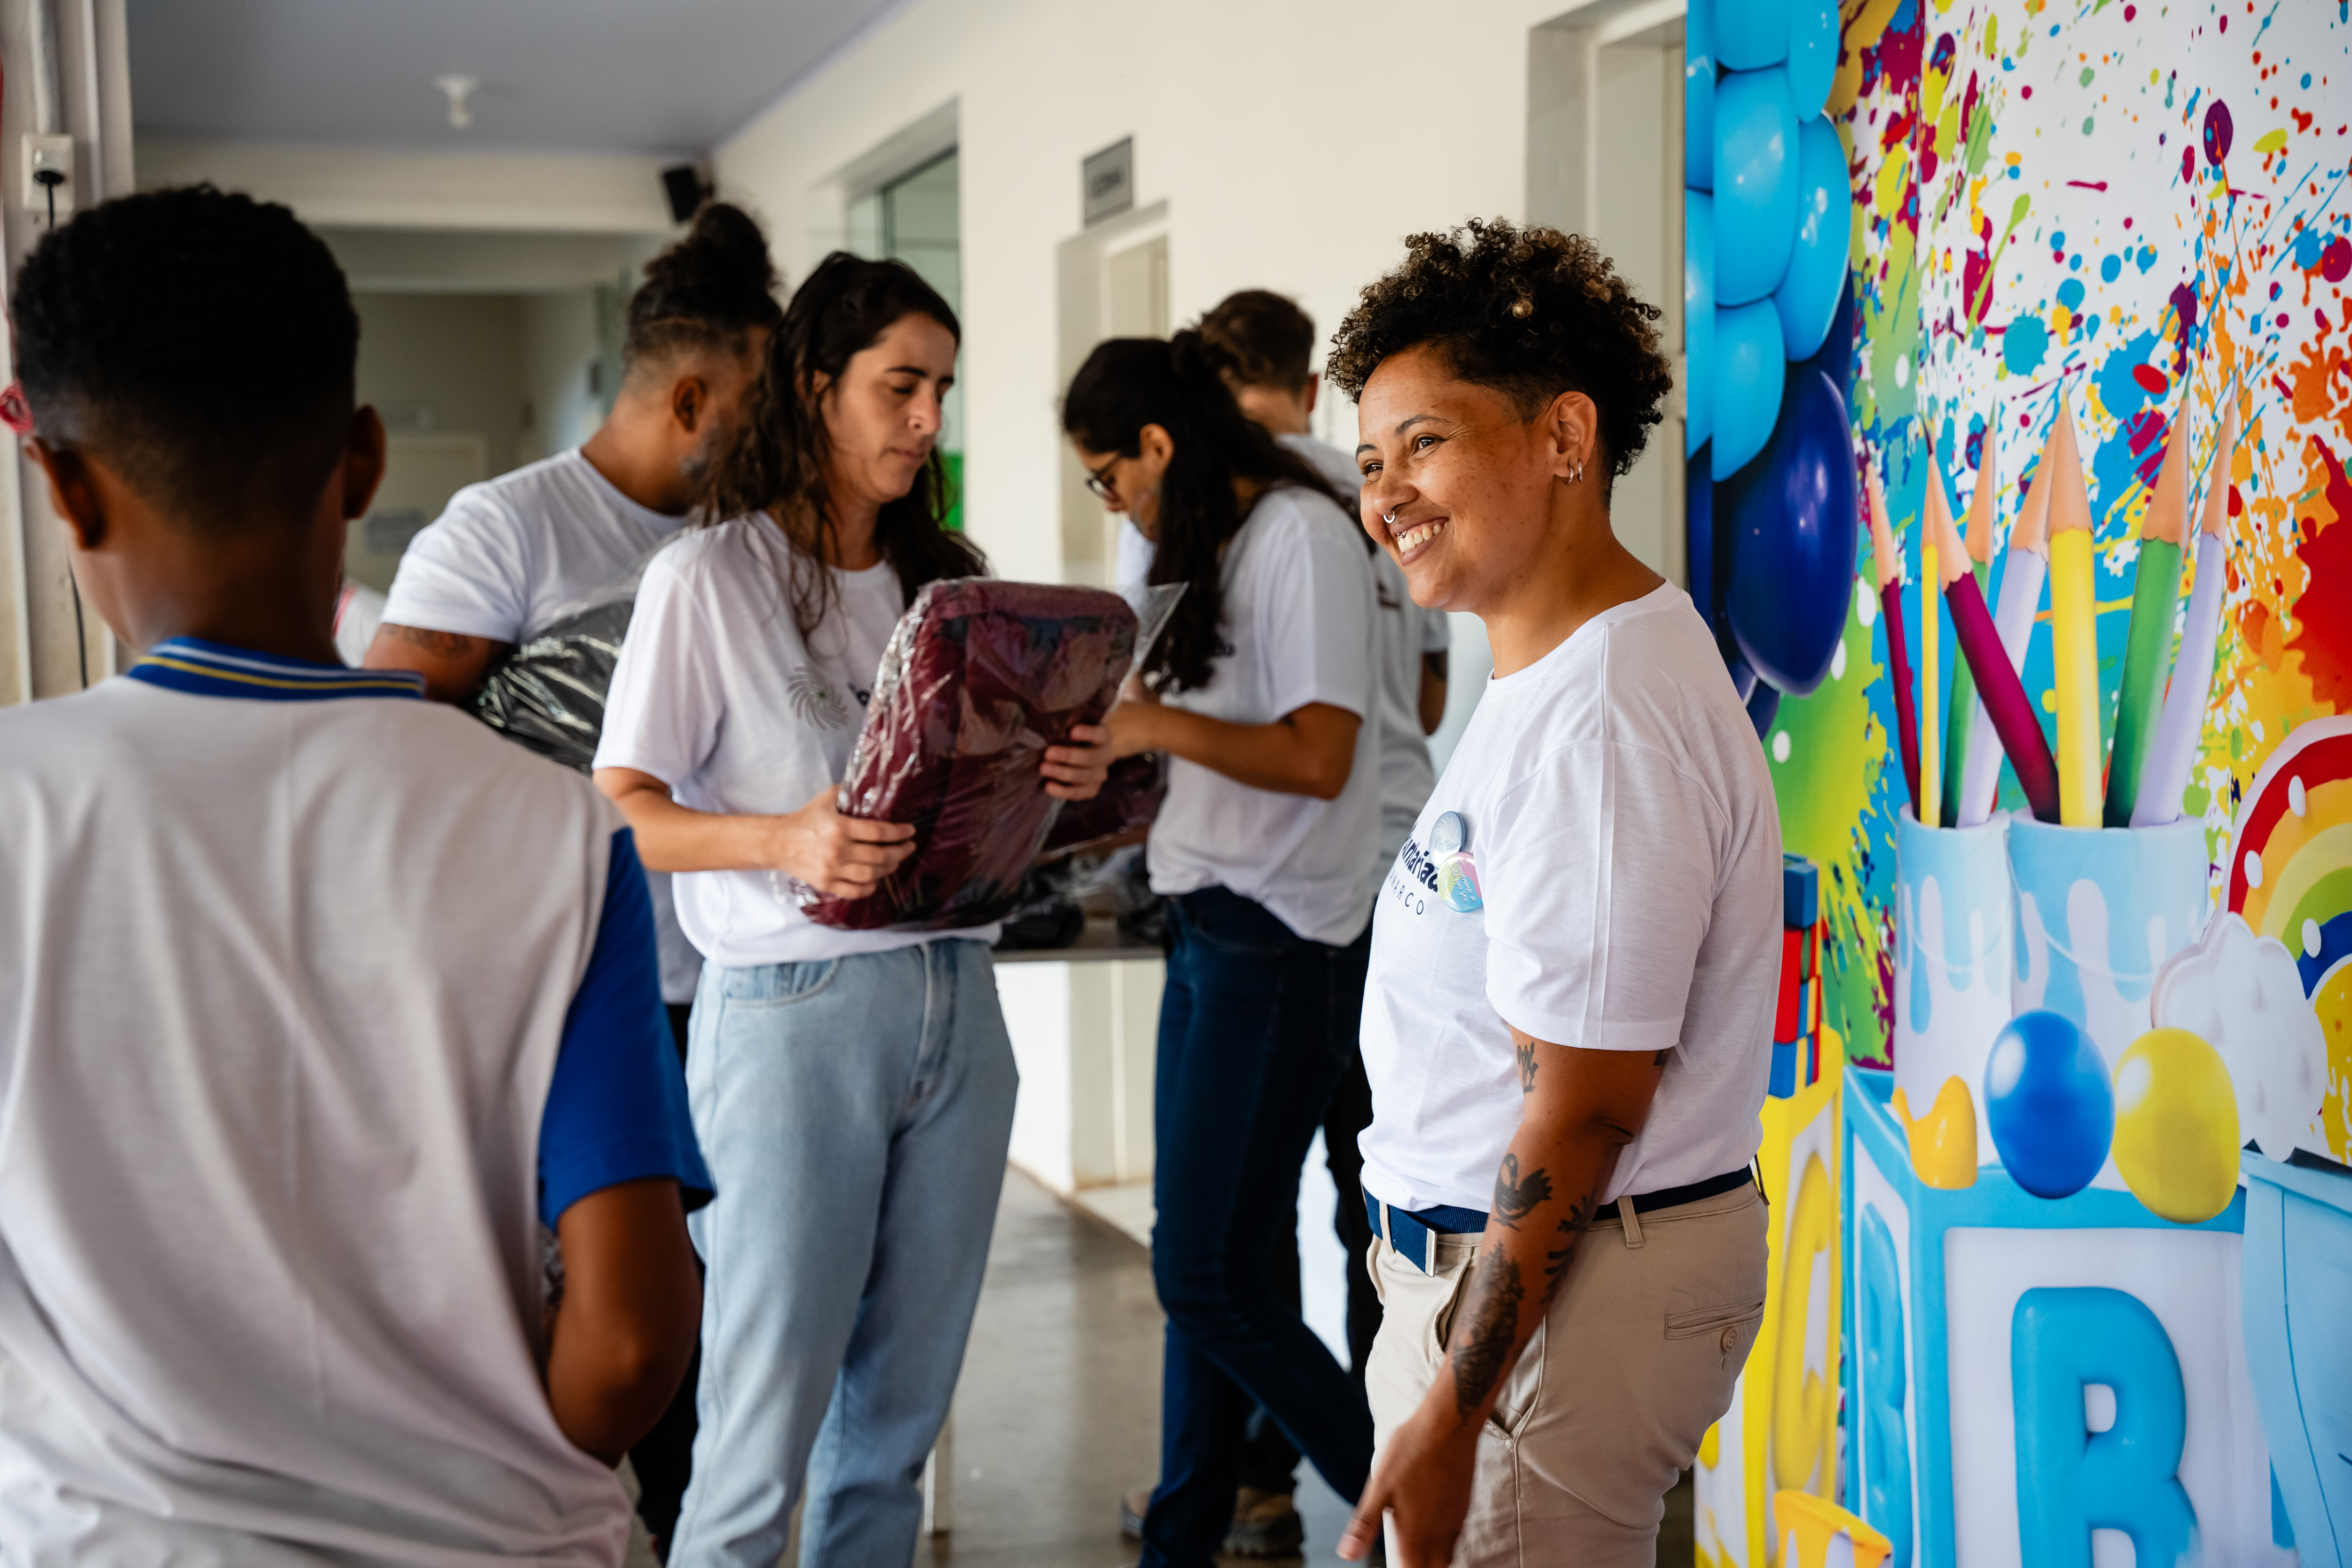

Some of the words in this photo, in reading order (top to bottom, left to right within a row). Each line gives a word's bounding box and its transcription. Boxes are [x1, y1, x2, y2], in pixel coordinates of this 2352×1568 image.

[1448, 864, 1458, 877] dentro
[1454, 879, 1462, 891] para
[1459, 892, 1468, 904] fora.
[1454, 860, 1472, 894] Transformando
